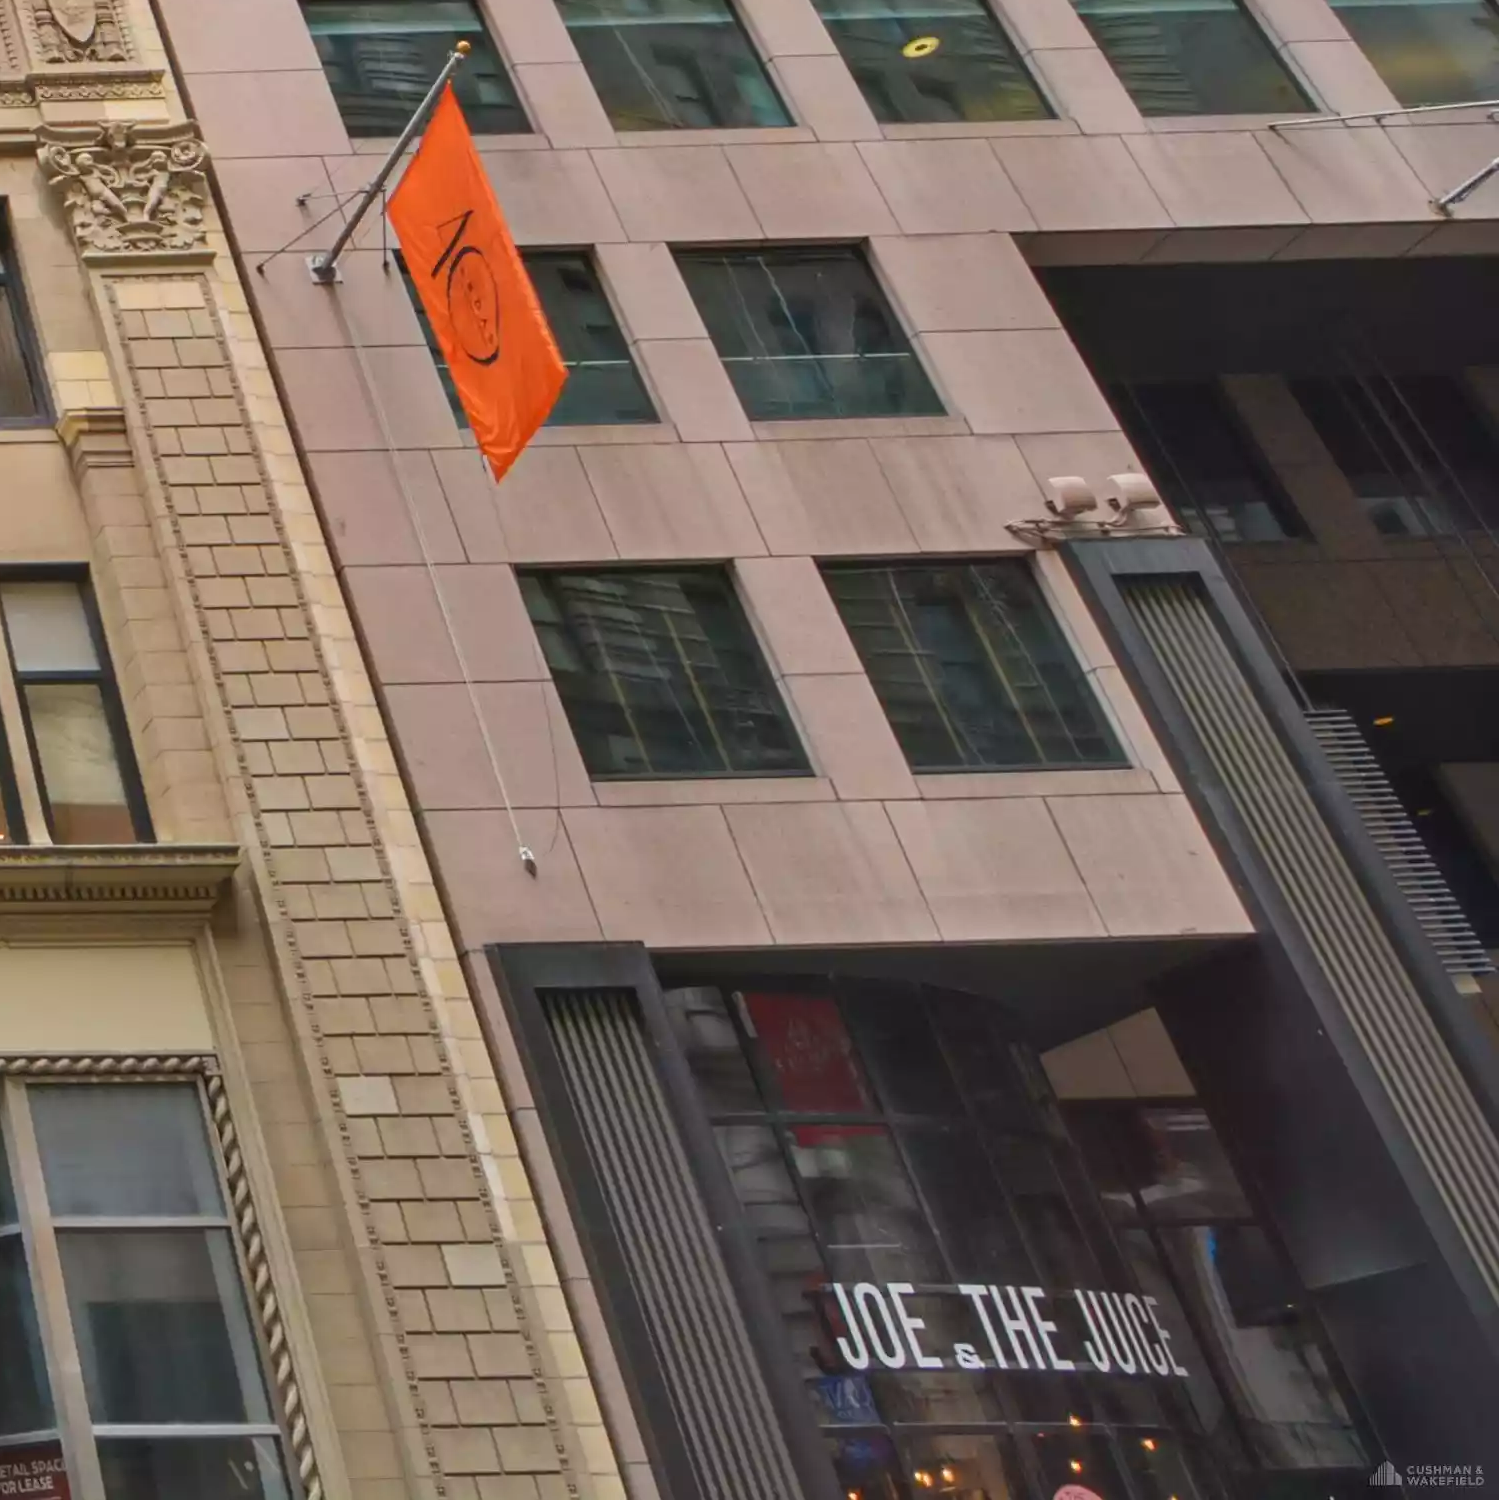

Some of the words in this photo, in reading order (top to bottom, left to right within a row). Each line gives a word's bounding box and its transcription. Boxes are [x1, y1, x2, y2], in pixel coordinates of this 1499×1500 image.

[833, 1282, 943, 1370] JOE
[953, 1343, 986, 1369] &
[958, 1284, 1076, 1370] THE
[1074, 1288, 1189, 1377] JUICE
[18, 1475, 54, 1493] LEASE
